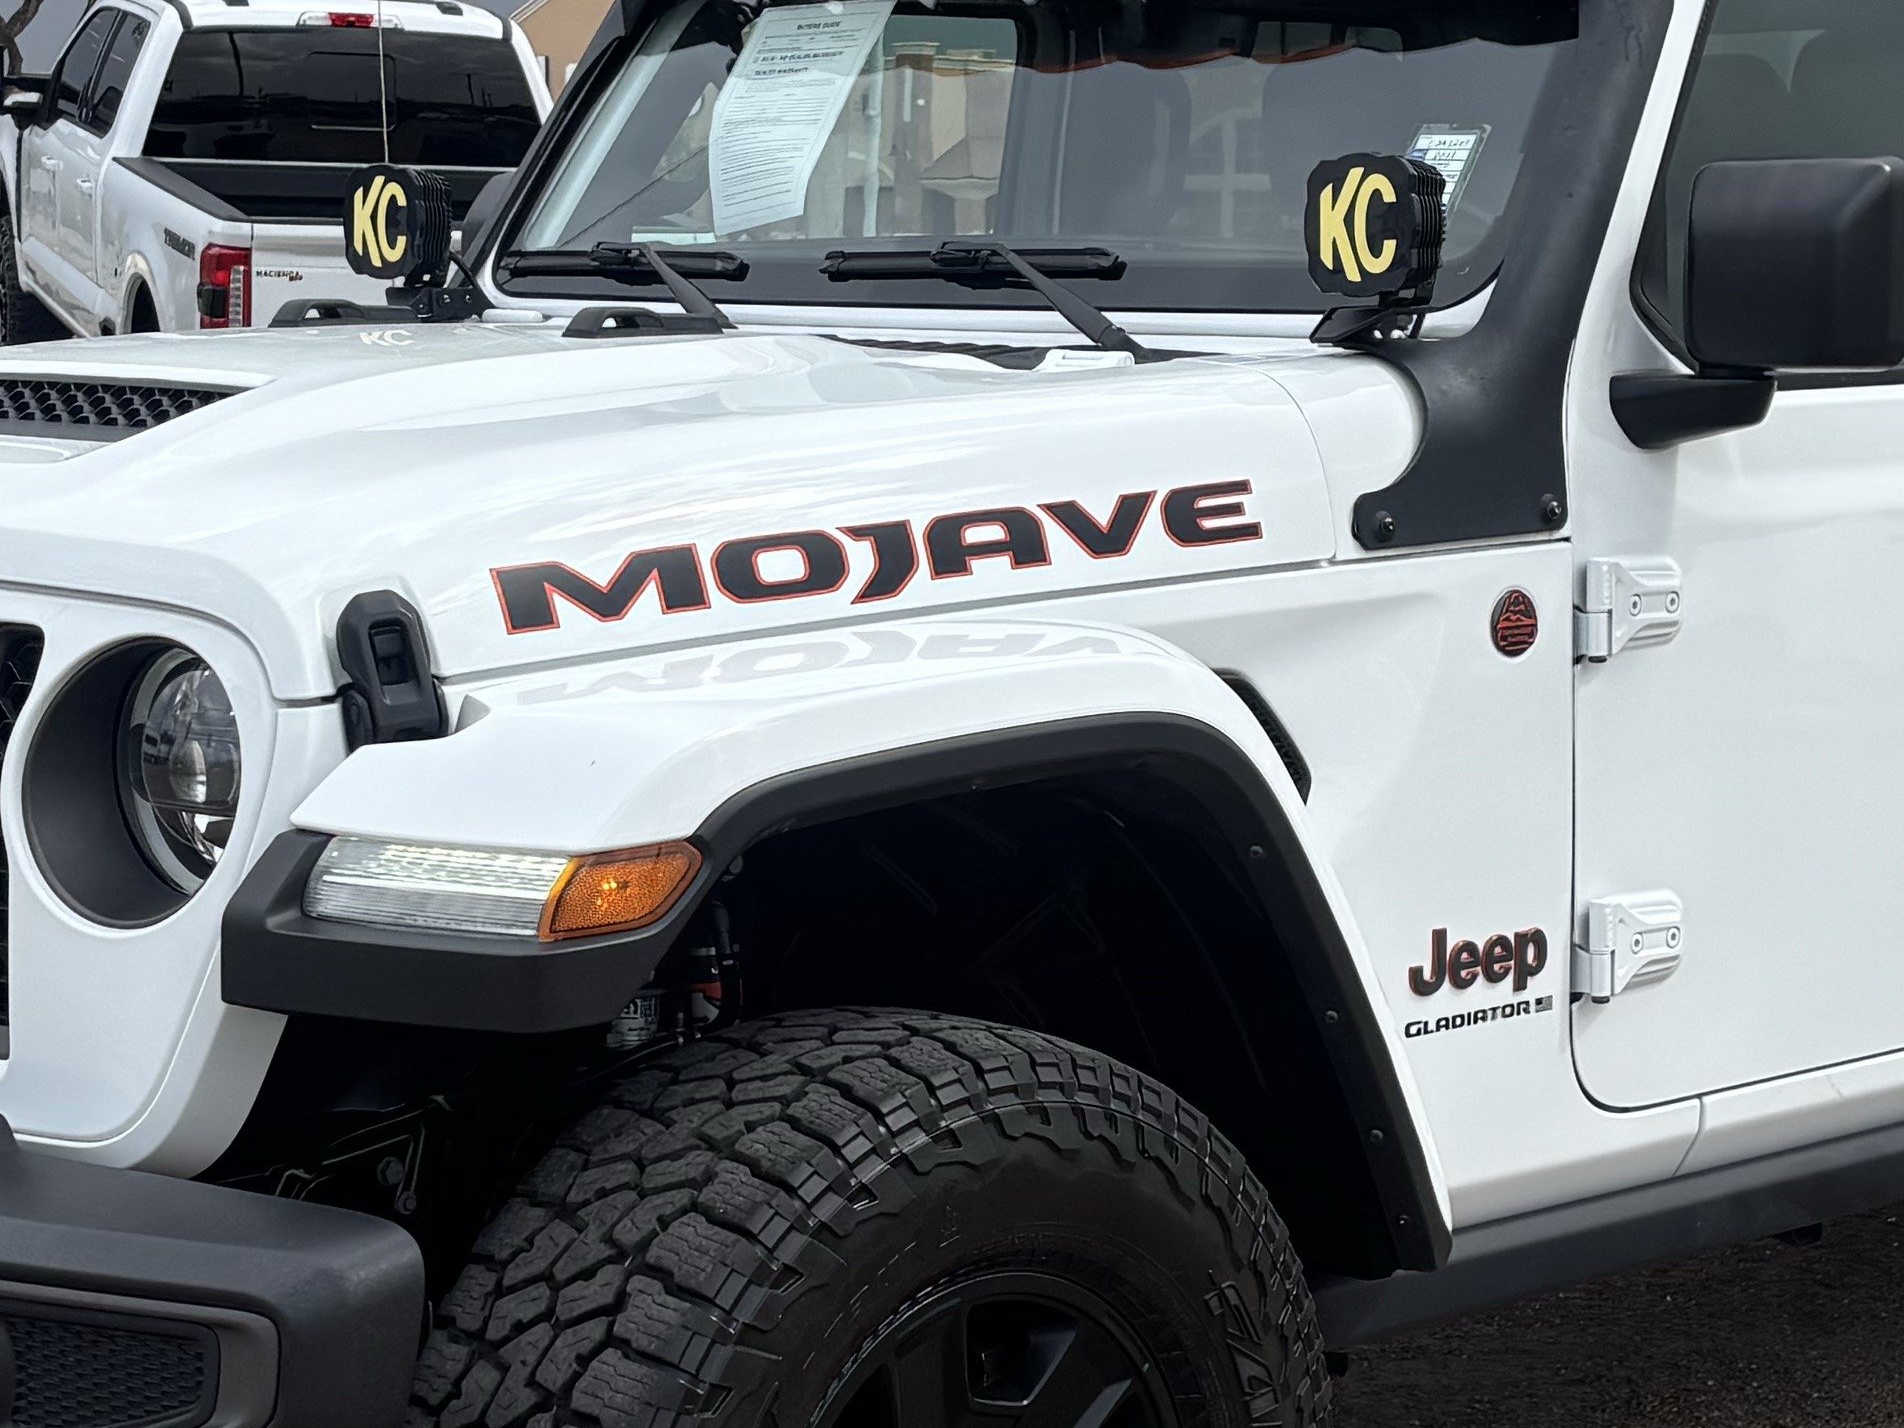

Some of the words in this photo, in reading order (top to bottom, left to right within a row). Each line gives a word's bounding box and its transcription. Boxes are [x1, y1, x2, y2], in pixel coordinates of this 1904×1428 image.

[353, 175, 408, 268] KC
[1319, 167, 1397, 282] KC
[490, 479, 1264, 636] MOJAVE
[1408, 926, 1548, 997] Jeep
[1404, 1000, 1531, 1039] GLADIATOR
